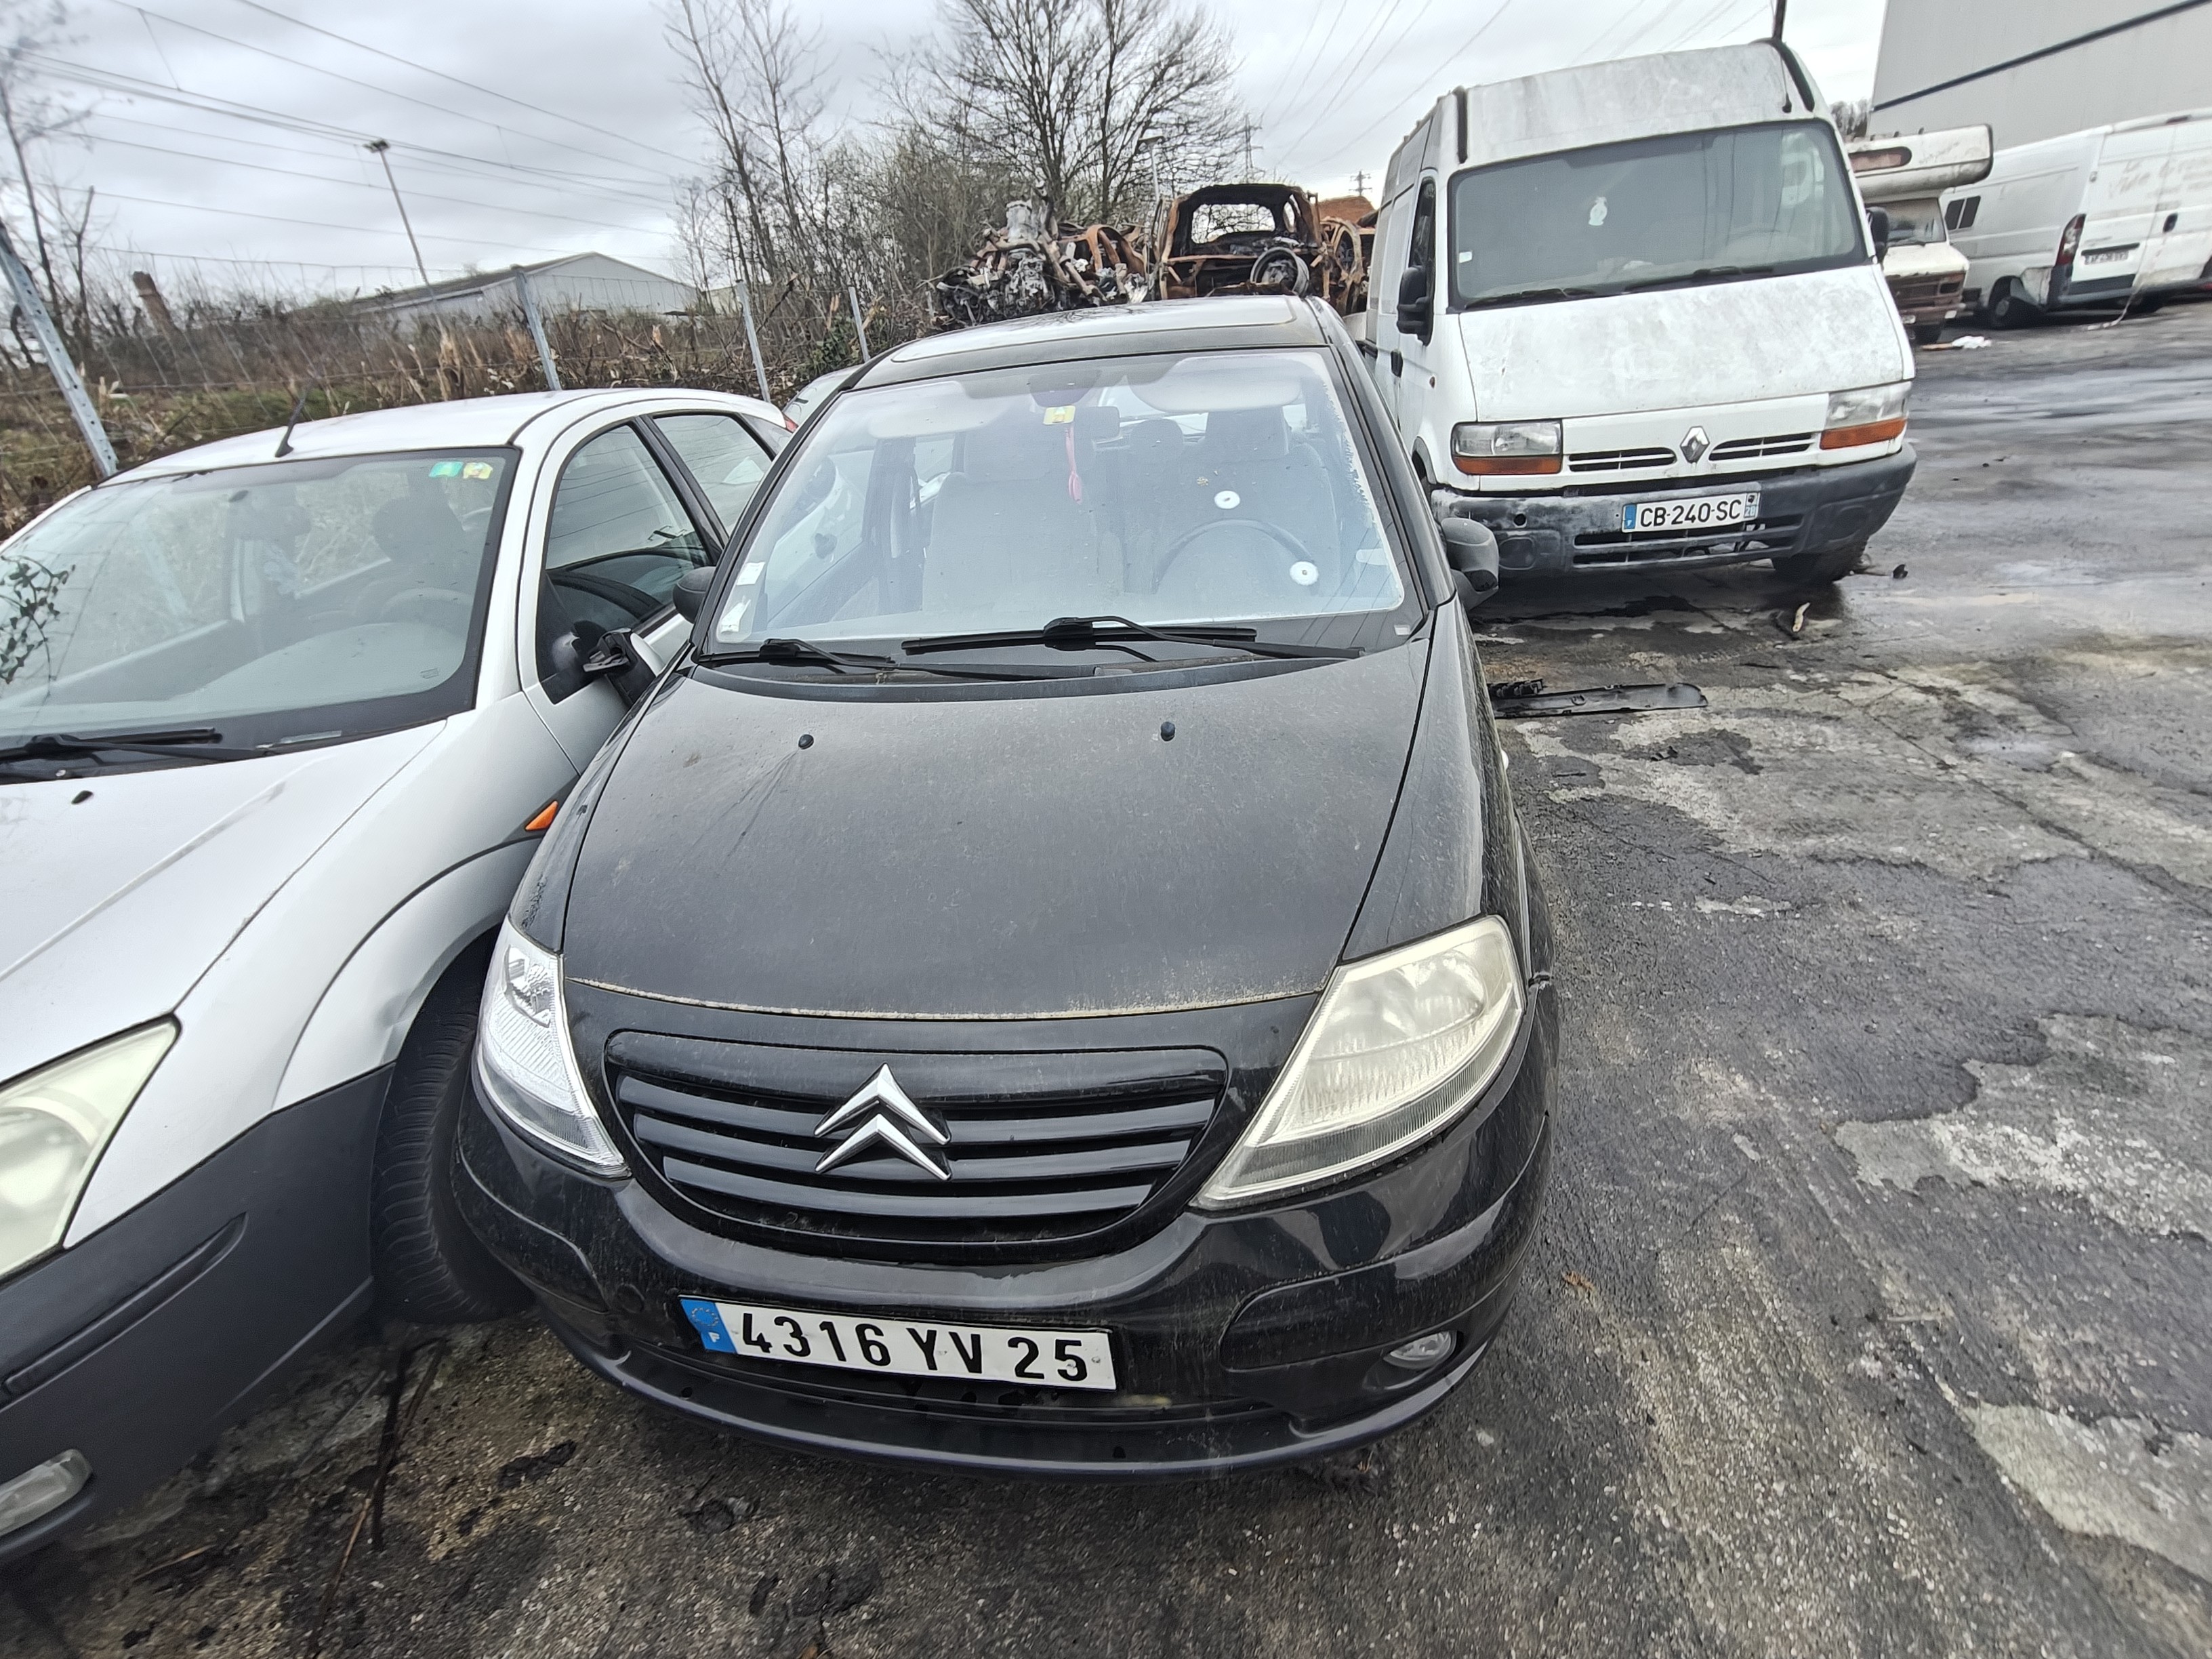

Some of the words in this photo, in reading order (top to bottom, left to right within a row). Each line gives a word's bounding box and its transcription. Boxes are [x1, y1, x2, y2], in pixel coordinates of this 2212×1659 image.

[1640, 499, 1742, 527] CB-240-SC
[743, 1312, 891, 1367] 4316
[905, 1327, 983, 1374] YV
[1007, 1336, 1088, 1382] 25
